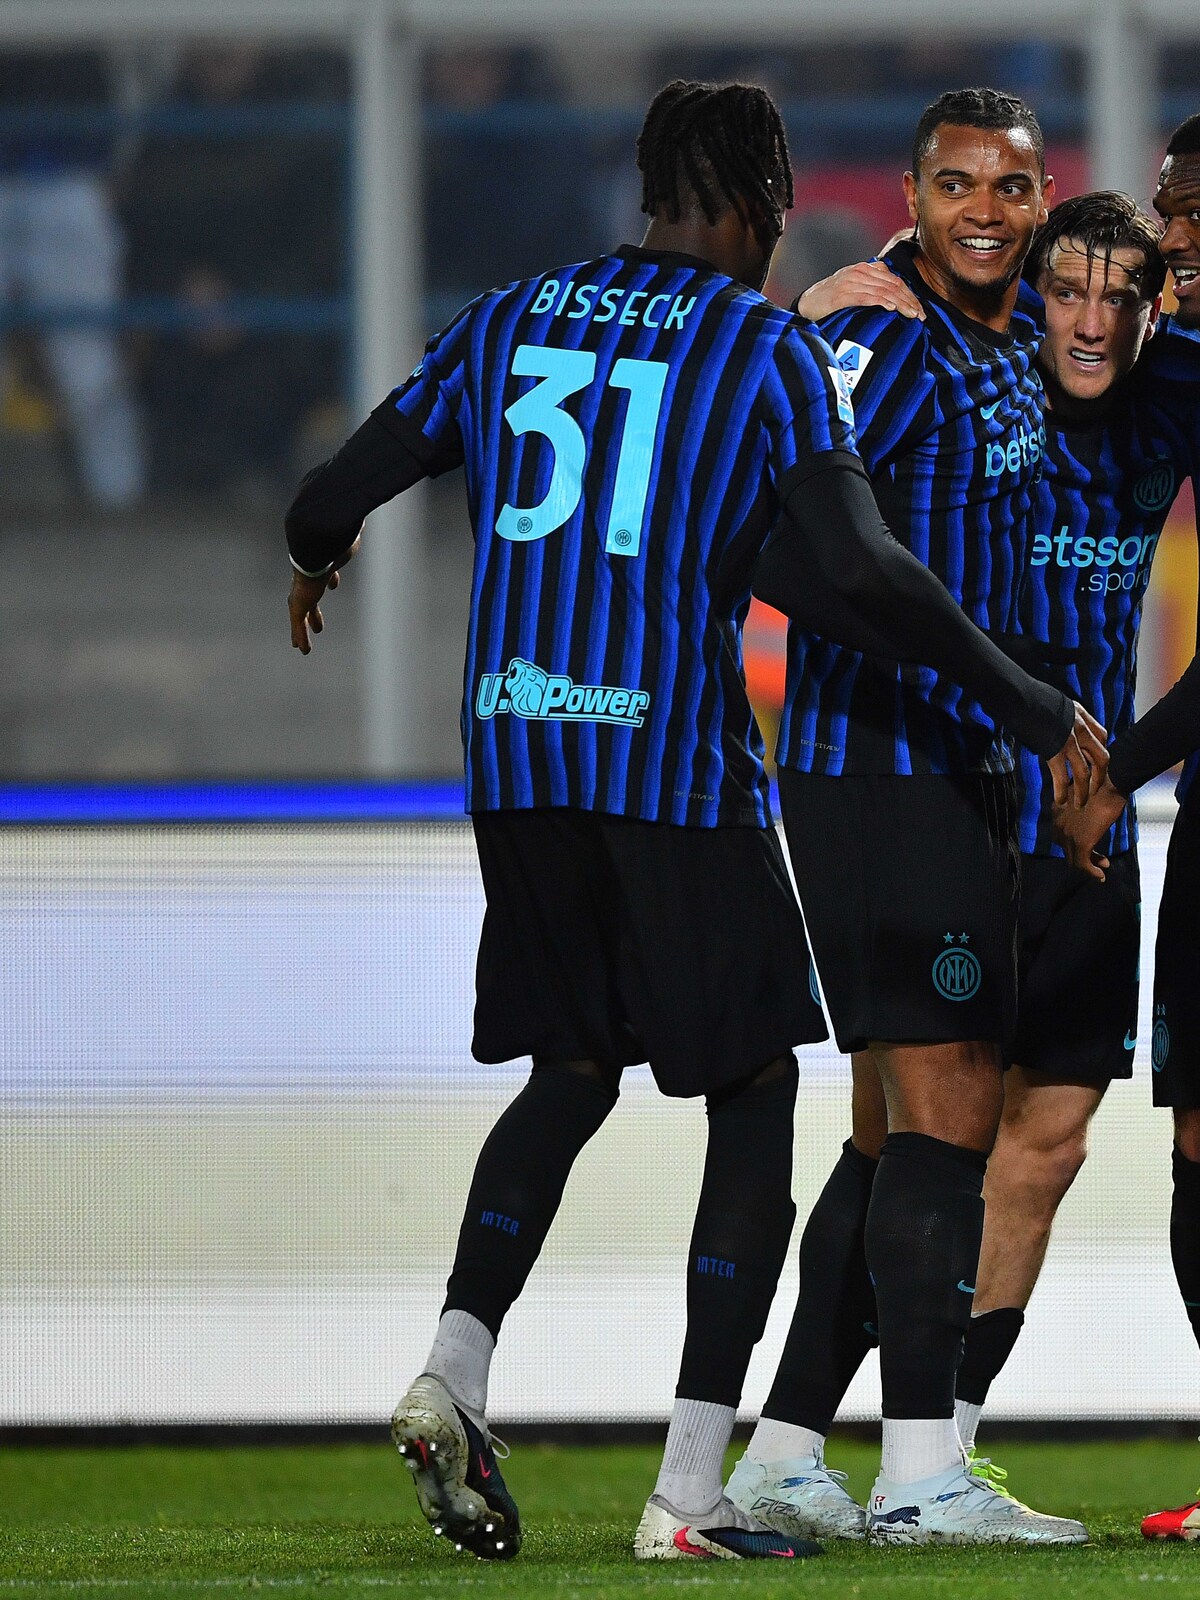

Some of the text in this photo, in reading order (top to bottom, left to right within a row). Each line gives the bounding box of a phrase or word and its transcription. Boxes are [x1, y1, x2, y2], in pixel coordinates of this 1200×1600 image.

[529, 278, 697, 331] BISSECK
[494, 344, 669, 557] 31
[1030, 525, 1158, 568] etsson
[481, 1210, 519, 1236] INTER
[697, 1255, 736, 1280] INTER
